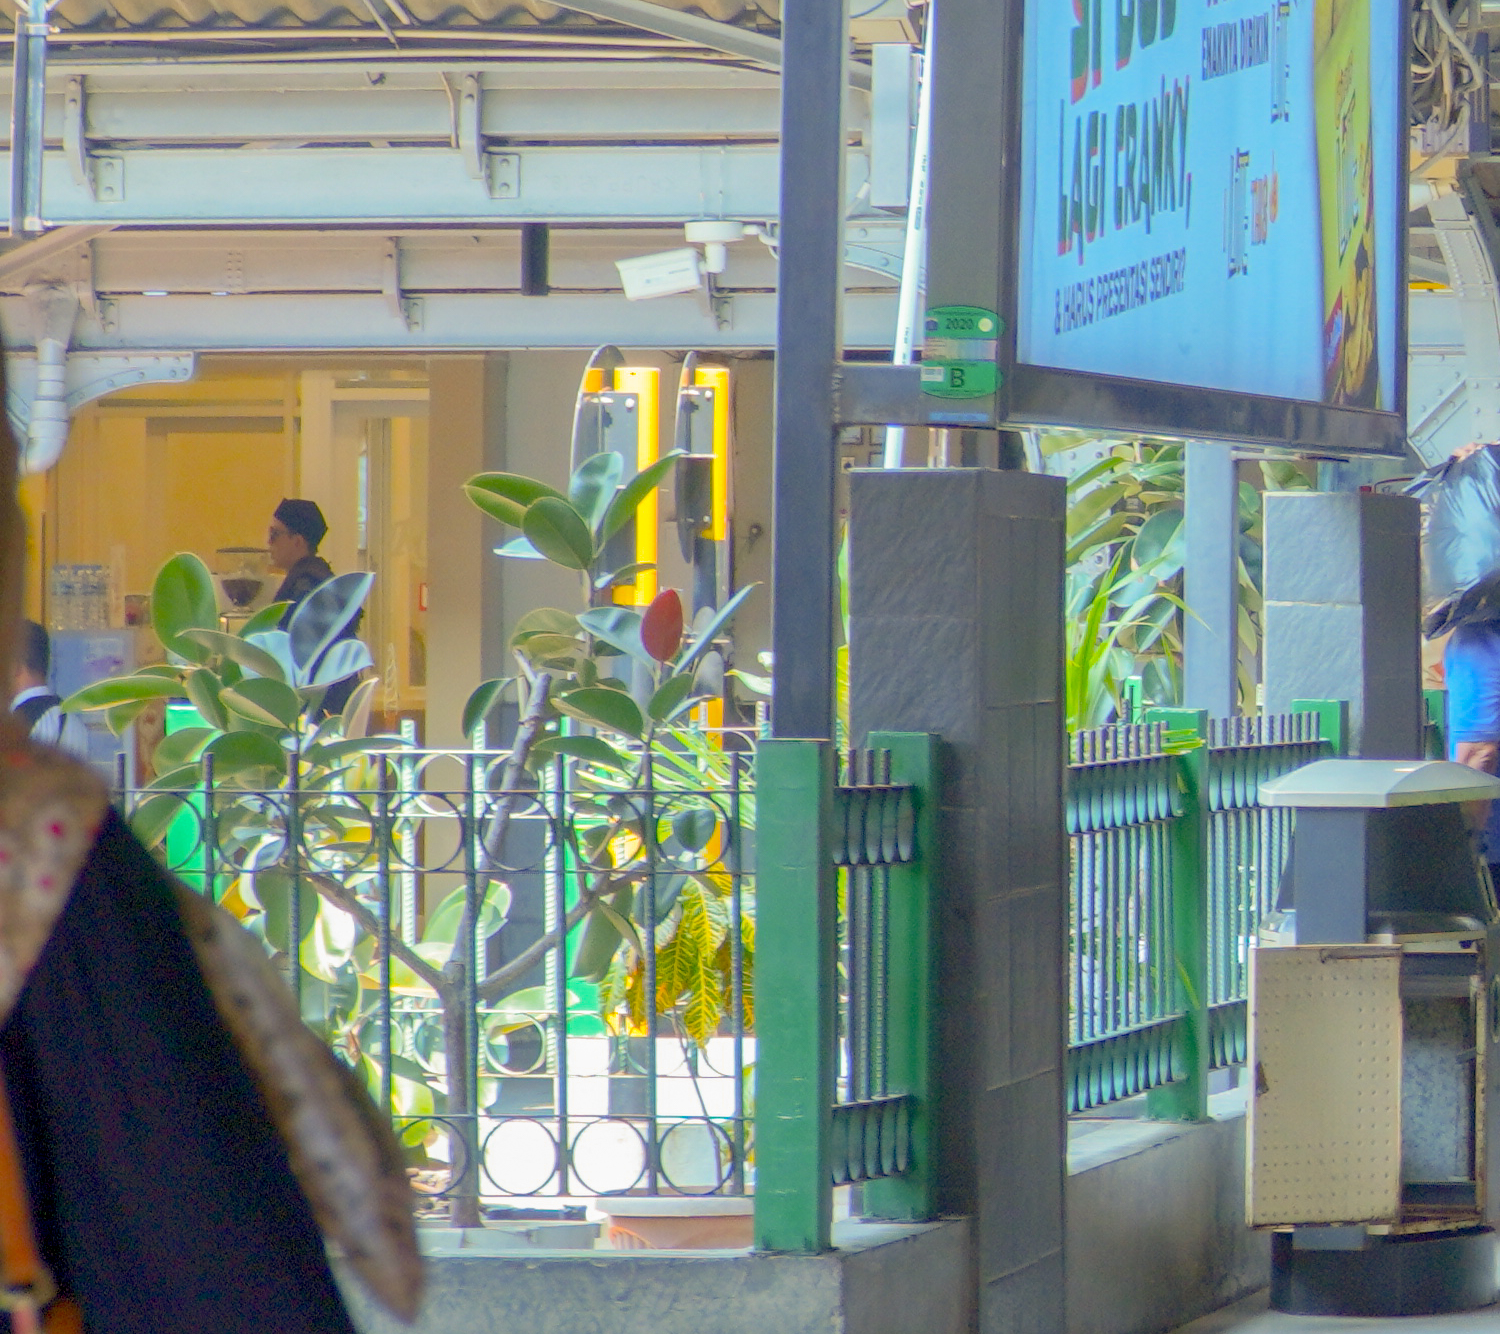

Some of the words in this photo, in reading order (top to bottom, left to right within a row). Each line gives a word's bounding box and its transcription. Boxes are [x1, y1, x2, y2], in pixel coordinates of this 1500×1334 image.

[1057, 99, 1106, 266] LAGI
[1063, 277, 1095, 332] HARUS
[1097, 260, 1148, 321] PRESENTASI
[946, 318, 974, 330] 2020
[950, 368, 966, 388] B
